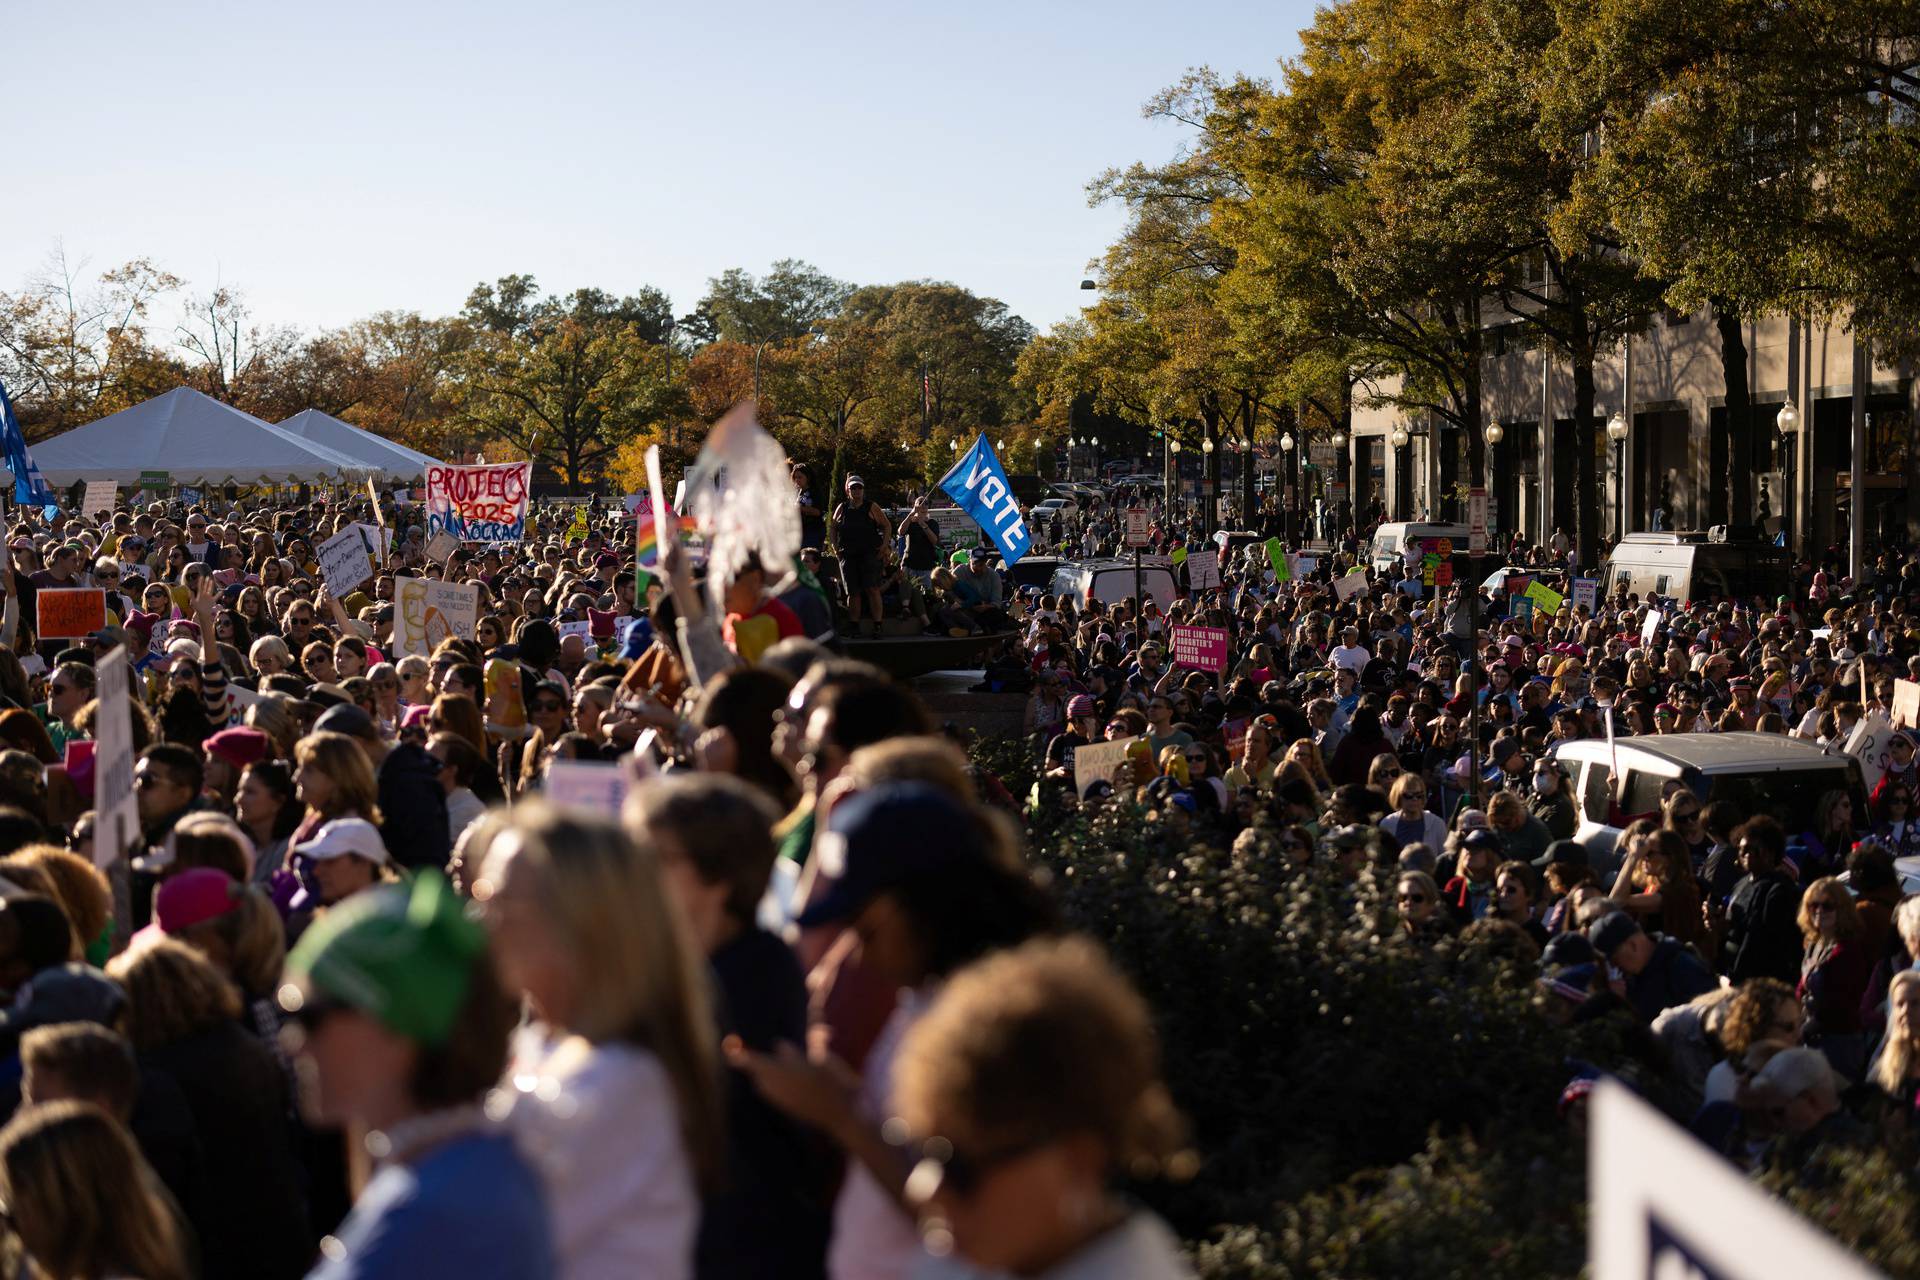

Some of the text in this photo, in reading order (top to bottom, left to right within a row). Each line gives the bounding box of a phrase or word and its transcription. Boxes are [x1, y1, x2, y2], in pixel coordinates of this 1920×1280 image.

[428, 464, 528, 505] PROJECT
[965, 453, 1025, 552] VOTE
[461, 503, 517, 525] 2025
[1176, 628, 1224, 641] VOTE LIKE YOUR
[1176, 637, 1213, 649] DAUGHTER'S
[1176, 645, 1199, 656] RIGHTS
[1176, 653, 1218, 666] DEPEND ON IT
